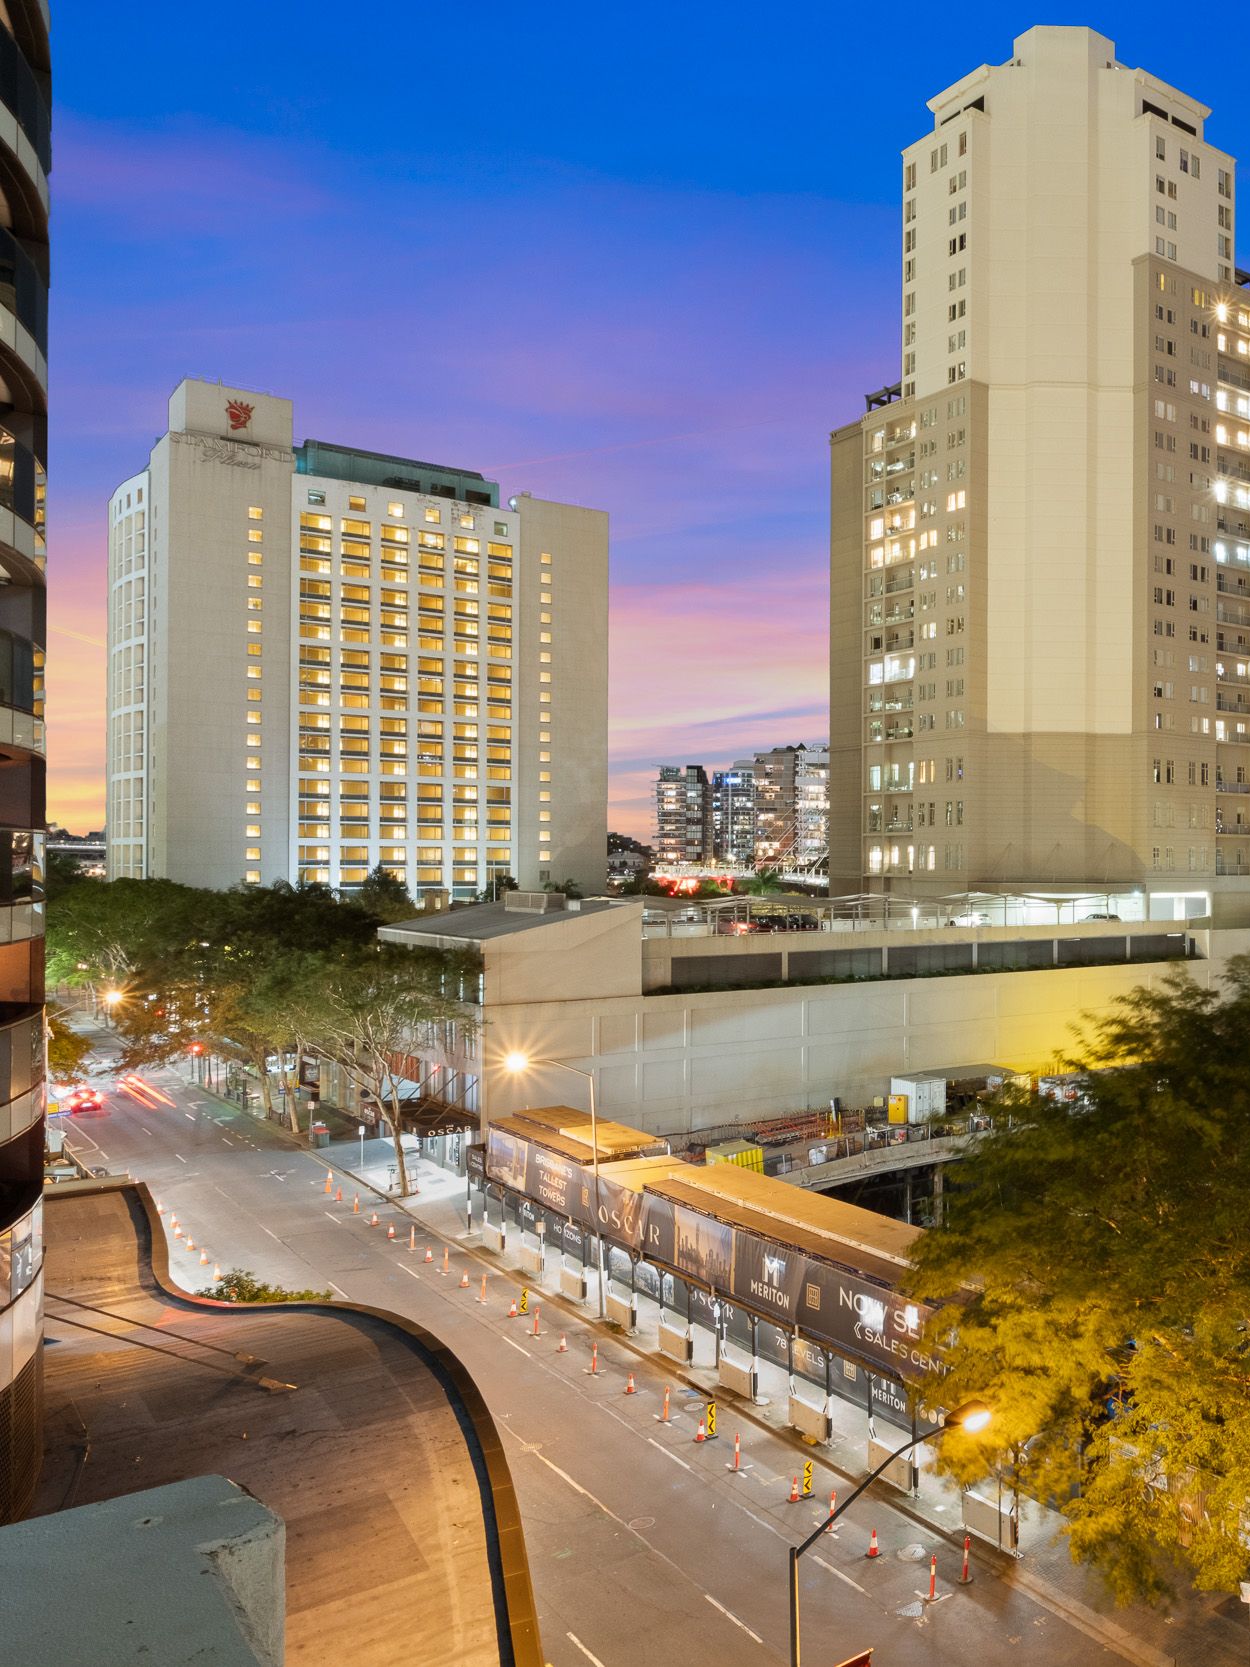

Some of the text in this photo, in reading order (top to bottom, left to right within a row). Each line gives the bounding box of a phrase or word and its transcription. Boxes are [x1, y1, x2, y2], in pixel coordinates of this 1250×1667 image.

[170, 432, 295, 463] STAMFORD
[428, 1125, 471, 1137] OSCAR
[539, 1169, 567, 1191] TALLEST
[538, 1184, 566, 1207] TOWERS
[553, 1223, 582, 1245] HOIZONS
[750, 1279, 790, 1310] MERITON
[775, 1335, 825, 1368] 78 EVELS
[864, 1327, 956, 1377] SALES CENT
[871, 1385, 906, 1414] MERITON
